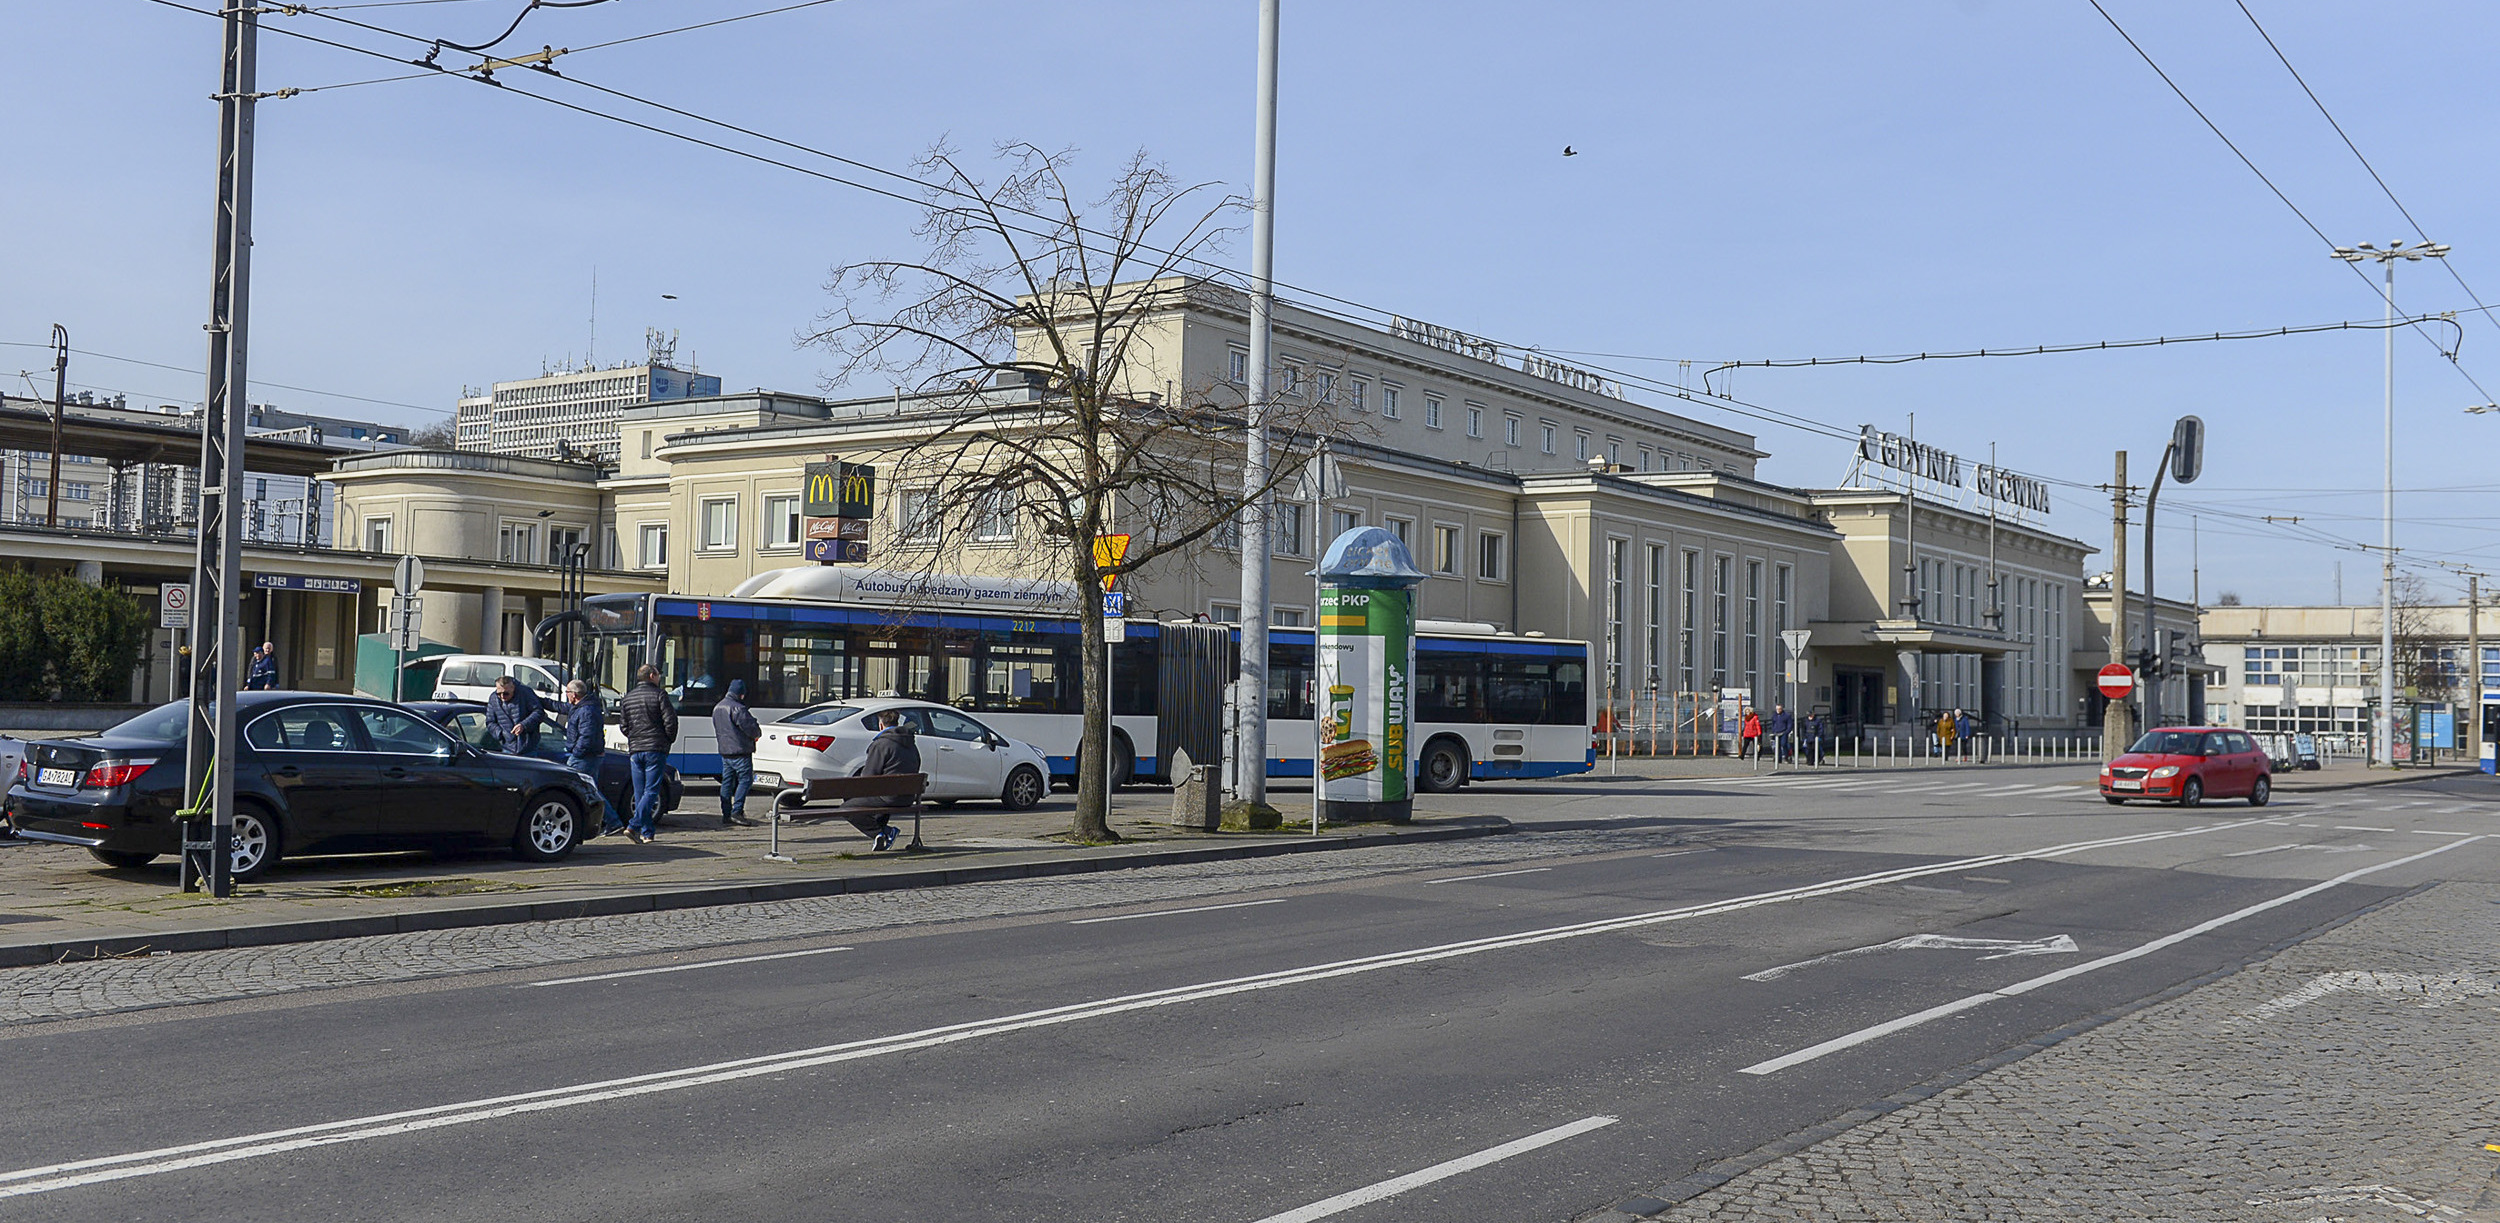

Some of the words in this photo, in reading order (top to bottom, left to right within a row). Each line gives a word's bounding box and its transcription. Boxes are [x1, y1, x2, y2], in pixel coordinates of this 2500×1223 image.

[1882, 432, 1962, 488] GDYNIA
[855, 580, 906, 593] Autobus
[974, 588, 1011, 600] gazem
[1013, 591, 1062, 604] ziemnym
[1341, 594, 1370, 606] PKP
[1103, 595, 1122, 614] AXI
[1013, 620, 1035, 632] 2212
[1388, 664, 1404, 772] SUBWAY
